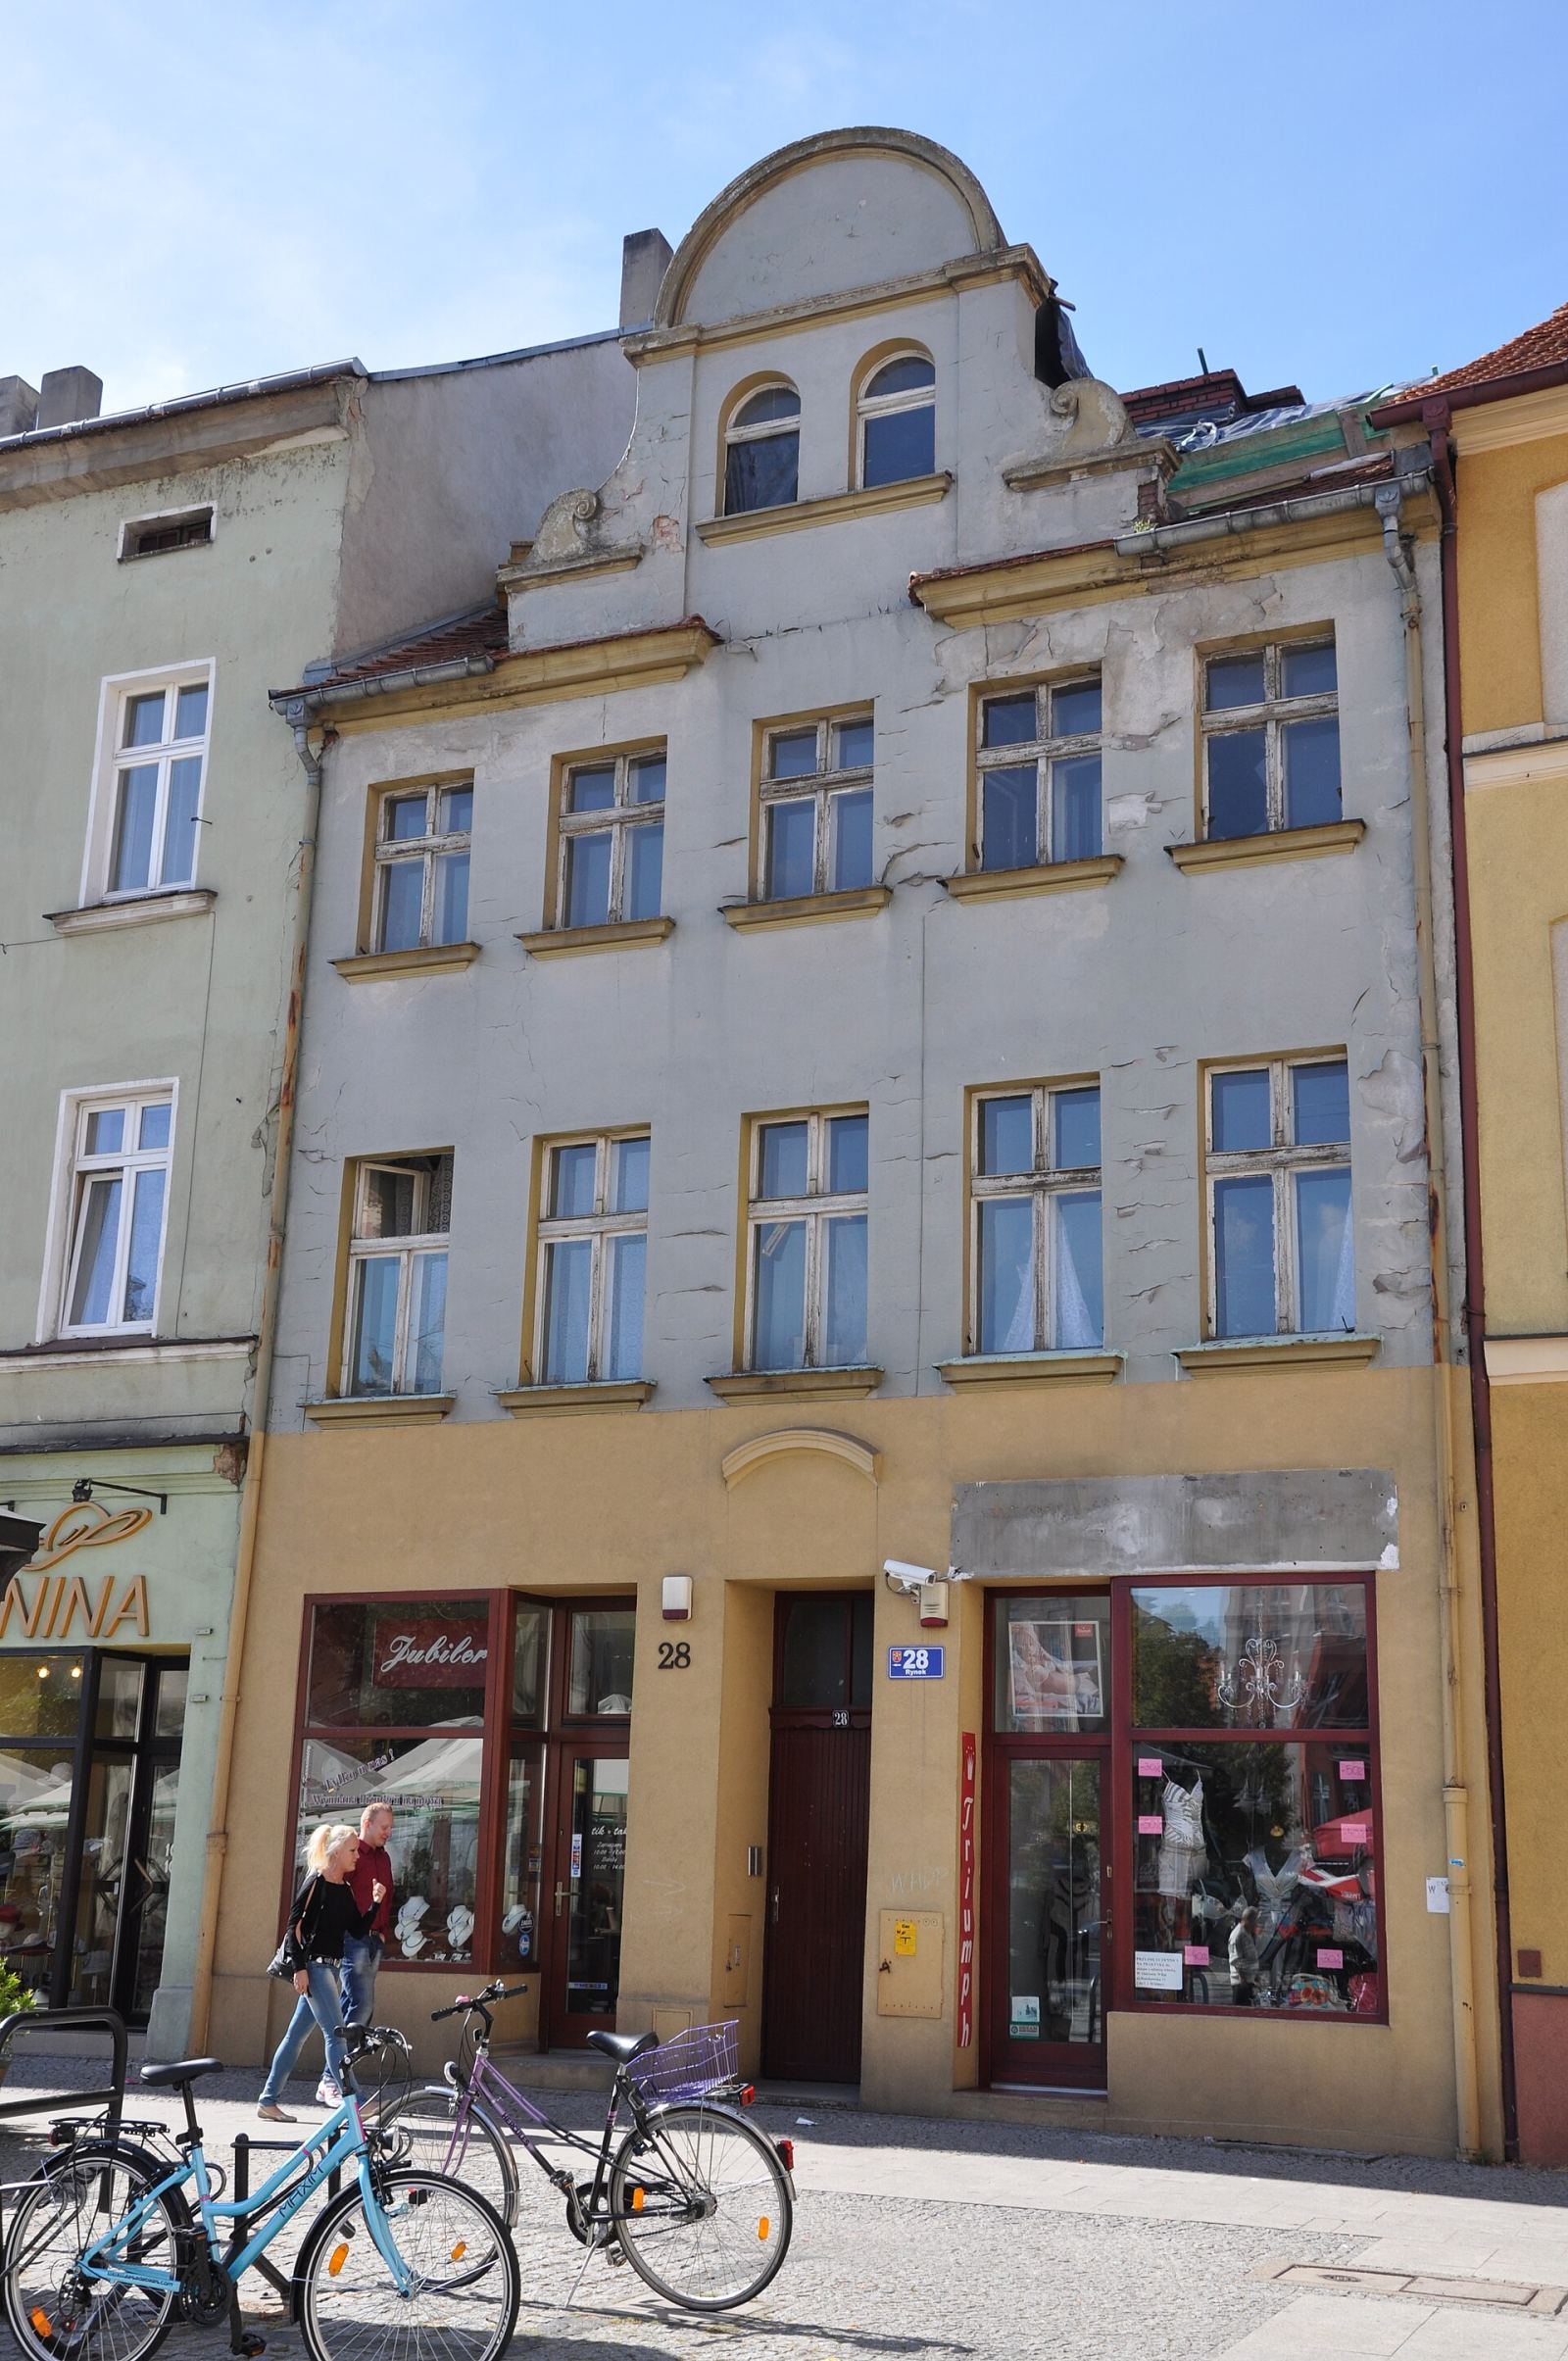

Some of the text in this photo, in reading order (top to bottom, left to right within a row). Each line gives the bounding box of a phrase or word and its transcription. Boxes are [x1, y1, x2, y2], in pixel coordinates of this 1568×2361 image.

[380, 1635, 488, 1674] Jubiler
[658, 1642, 692, 1669] 28
[903, 1649, 929, 1670] 28
[834, 1711, 849, 1727] 28
[961, 1796, 973, 2046] Triumph
[502, 2112, 530, 2146] HERCULES
[278, 2162, 324, 2219] MAXIM
